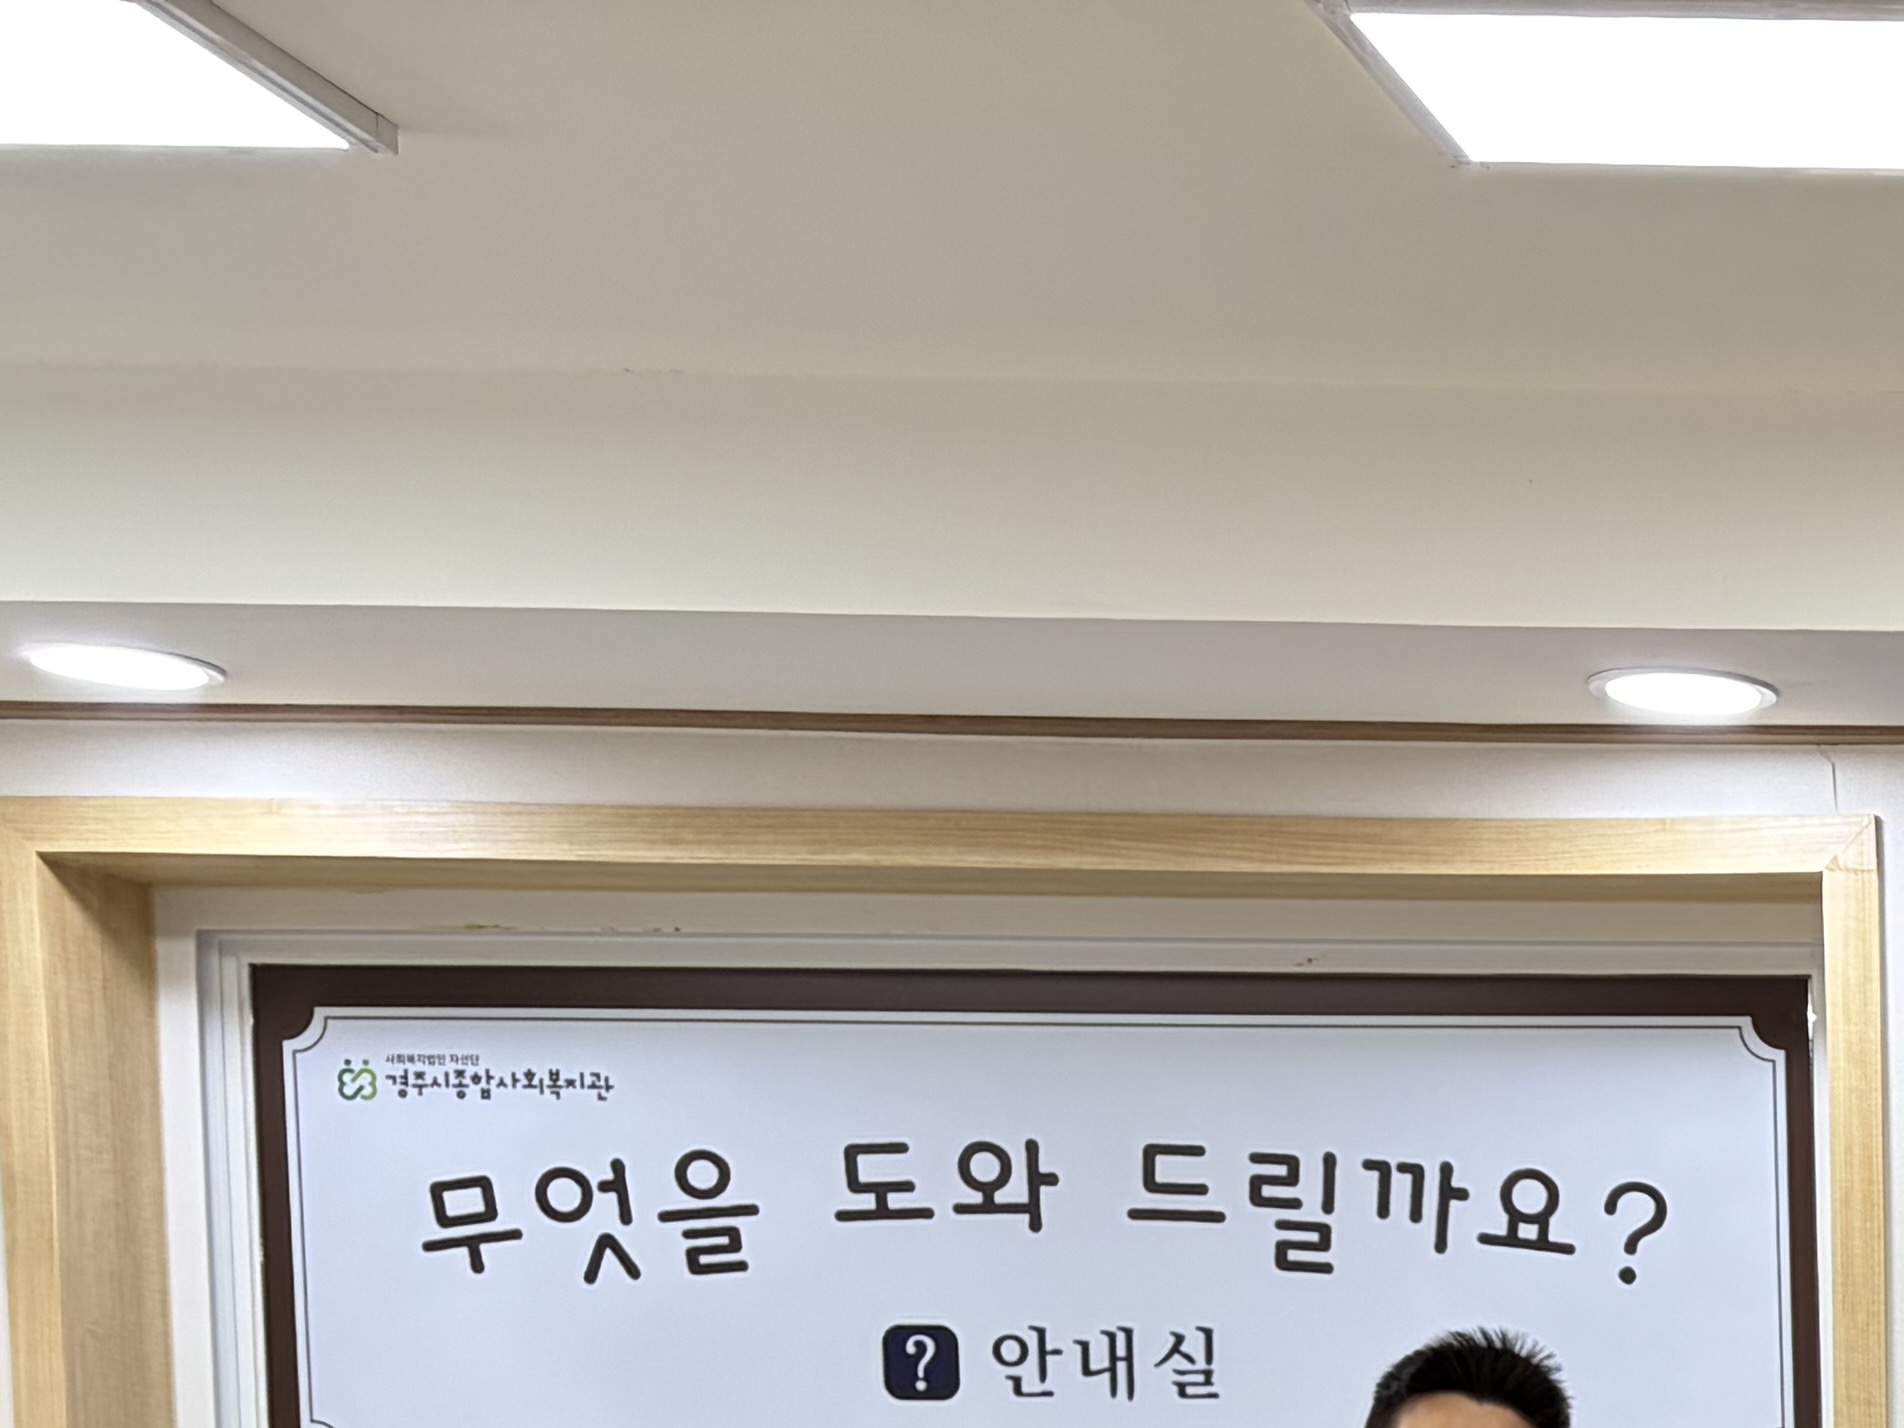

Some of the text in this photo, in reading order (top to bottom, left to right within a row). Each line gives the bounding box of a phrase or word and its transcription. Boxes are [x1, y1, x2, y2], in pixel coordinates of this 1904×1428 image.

[385, 1069, 614, 1102] 경주시종합사회복지관
[420, 1138, 1670, 1286] 무엇을 도와 드릴까요?
[992, 1324, 1221, 1403] 안내실
